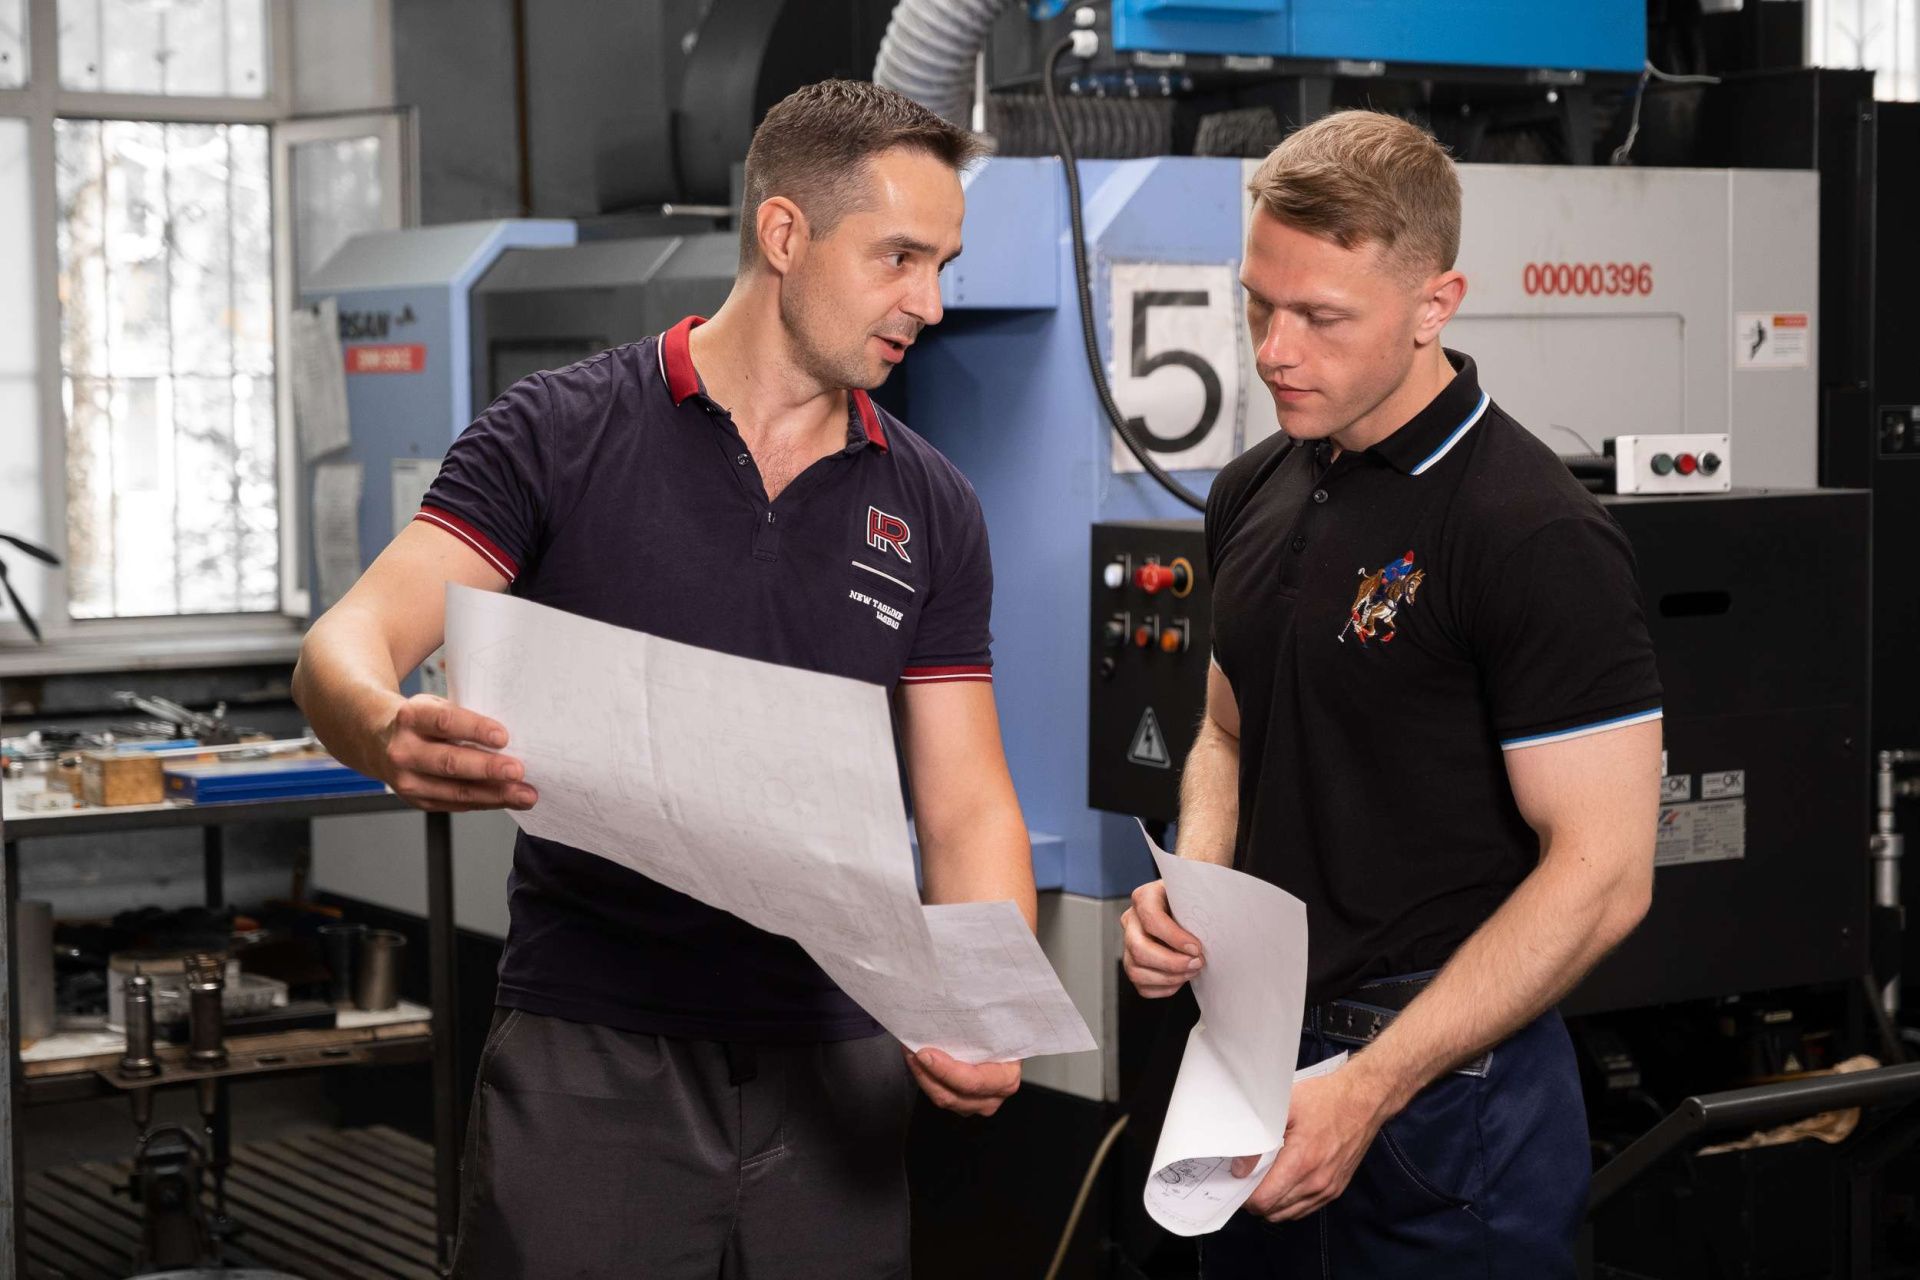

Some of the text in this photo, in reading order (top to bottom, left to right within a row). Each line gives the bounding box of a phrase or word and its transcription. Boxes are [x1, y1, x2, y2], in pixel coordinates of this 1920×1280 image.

[1523, 263, 1653, 295] 00000396
[1127, 290, 1222, 453] 5
[849, 589, 872, 605] NEW
[1668, 777, 1687, 791] OK
[1723, 772, 1741, 787] OK
